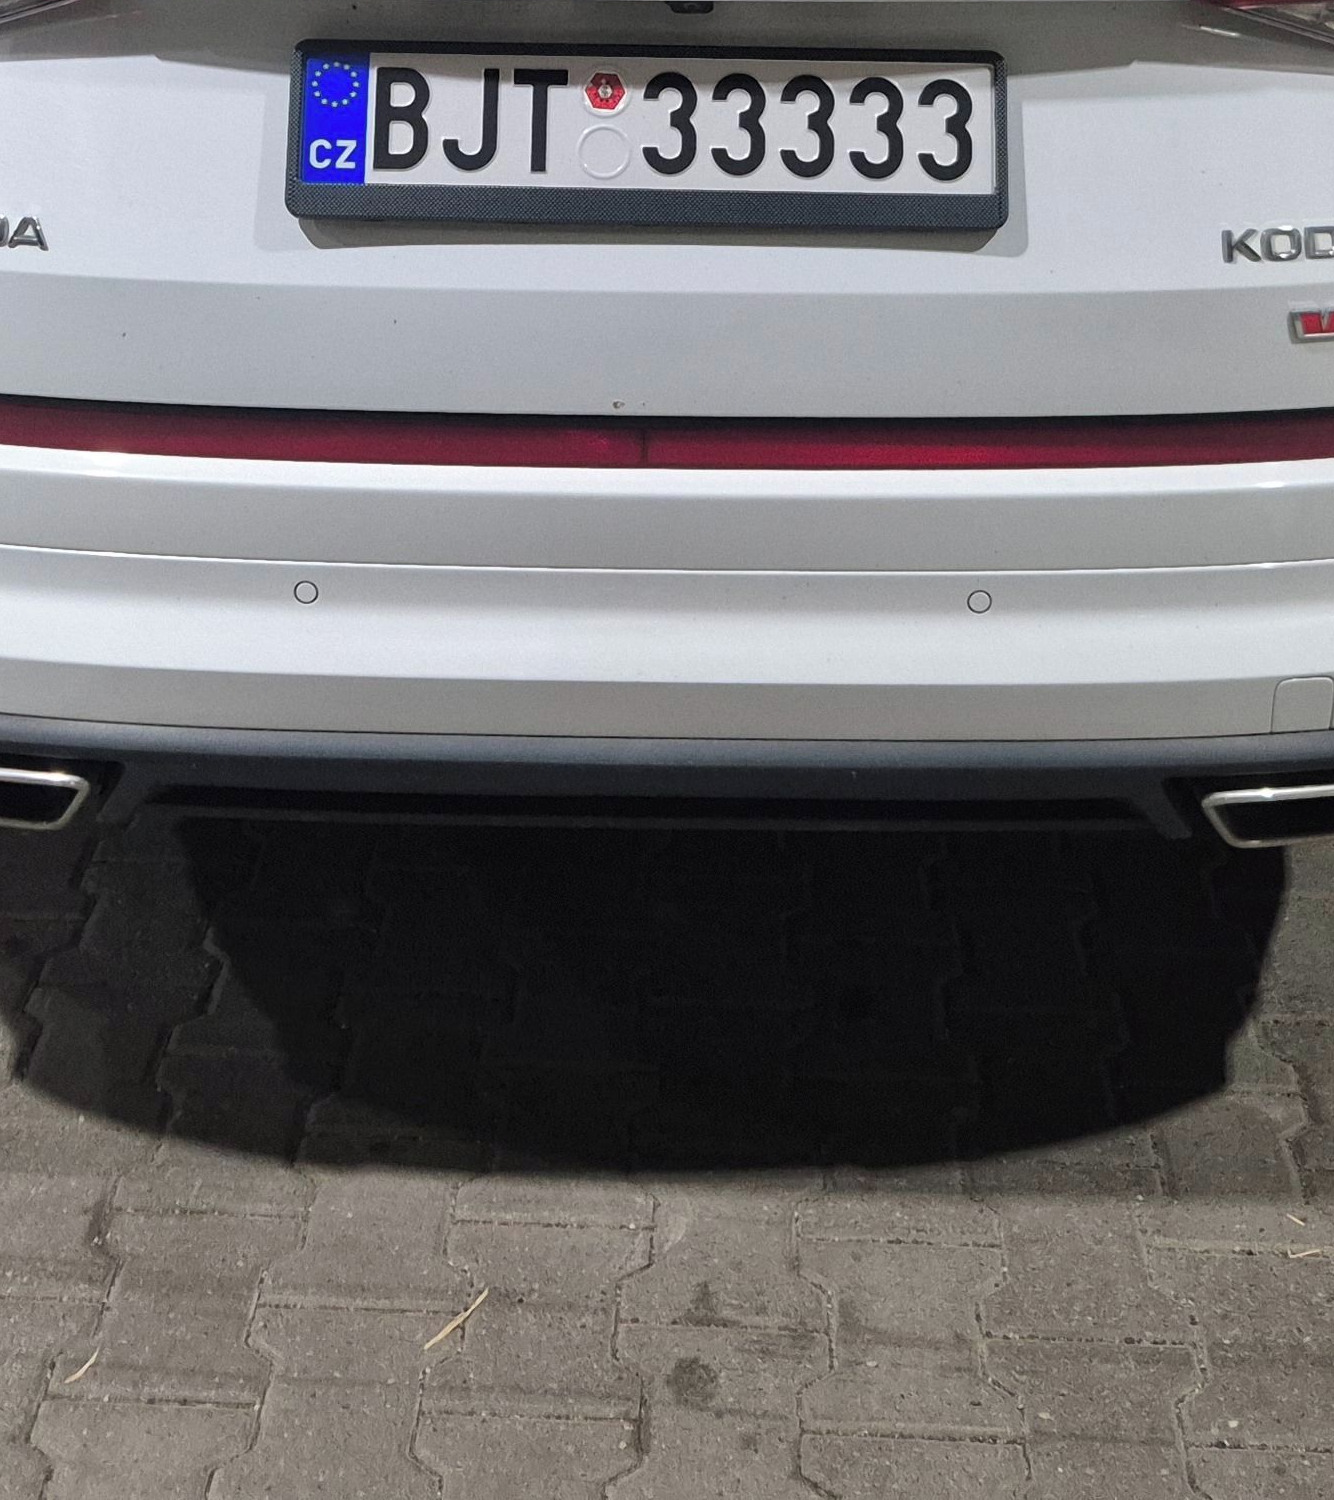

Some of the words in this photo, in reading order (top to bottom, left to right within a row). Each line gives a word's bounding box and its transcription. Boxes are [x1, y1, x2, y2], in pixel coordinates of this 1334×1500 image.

[310, 139, 357, 169] CZ
[372, 66, 568, 172] BJT
[642, 71, 973, 181] 33333
